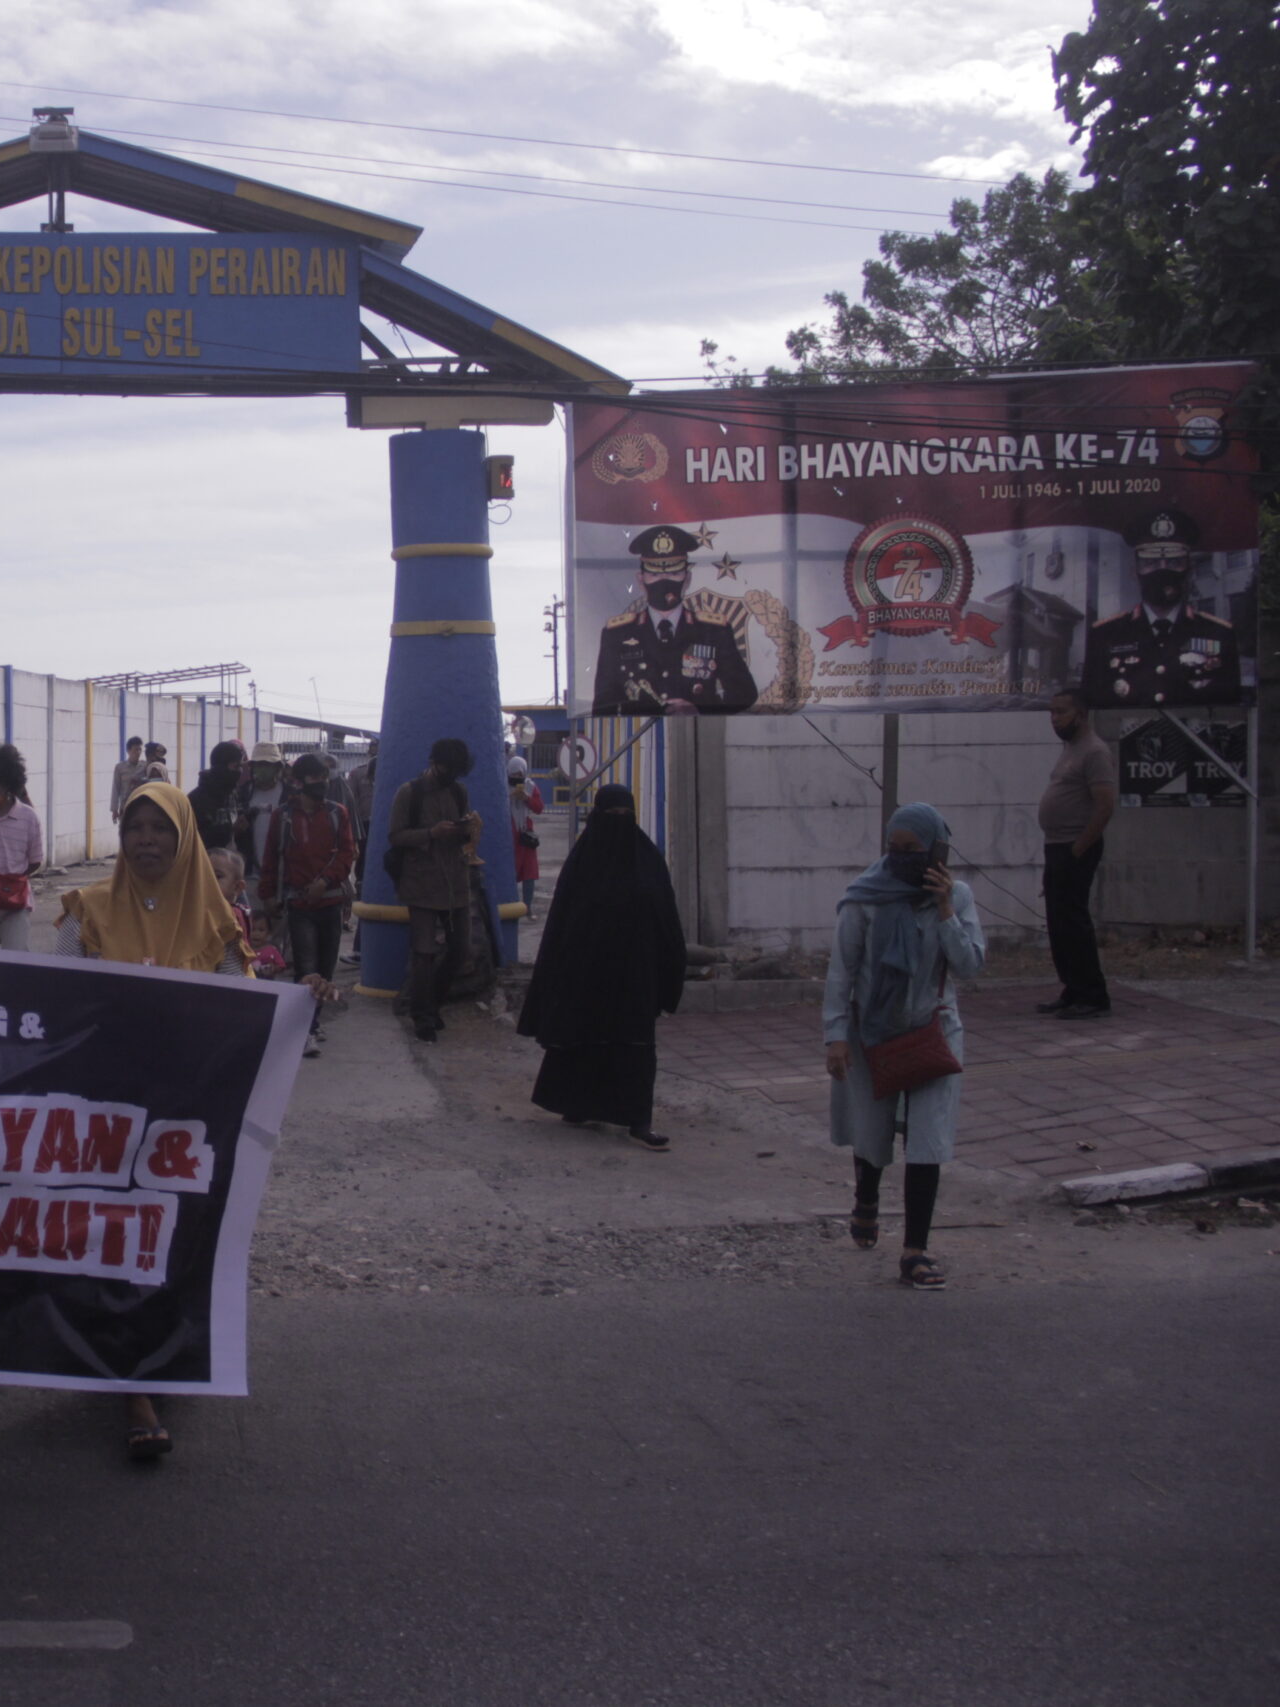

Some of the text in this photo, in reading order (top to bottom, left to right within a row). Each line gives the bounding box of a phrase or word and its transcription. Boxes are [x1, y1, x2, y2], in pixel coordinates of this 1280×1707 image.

[189, 247, 346, 296] PERAIRAN
[63, 307, 201, 357] SUL-SEL
[686, 428, 1160, 483] HARI BHAYANGKARA KE-74
[980, 486, 986, 498] 1
[991, 485, 1021, 499] JULI
[1027, 482, 1062, 498] 1946
[1078, 481, 1084, 495] 1
[1089, 480, 1120, 495] JULI
[1125, 477, 1161, 494] 2020
[893, 558, 923, 601] 74
[868, 607, 951, 624] BHAYANGKARA
[817, 657, 916, 677] Kamtibmas
[885, 681, 956, 698] semakin
[1126, 761, 1176, 778] TROY
[18, 1012, 46, 1039] &
[147, 1129, 202, 1180] &
